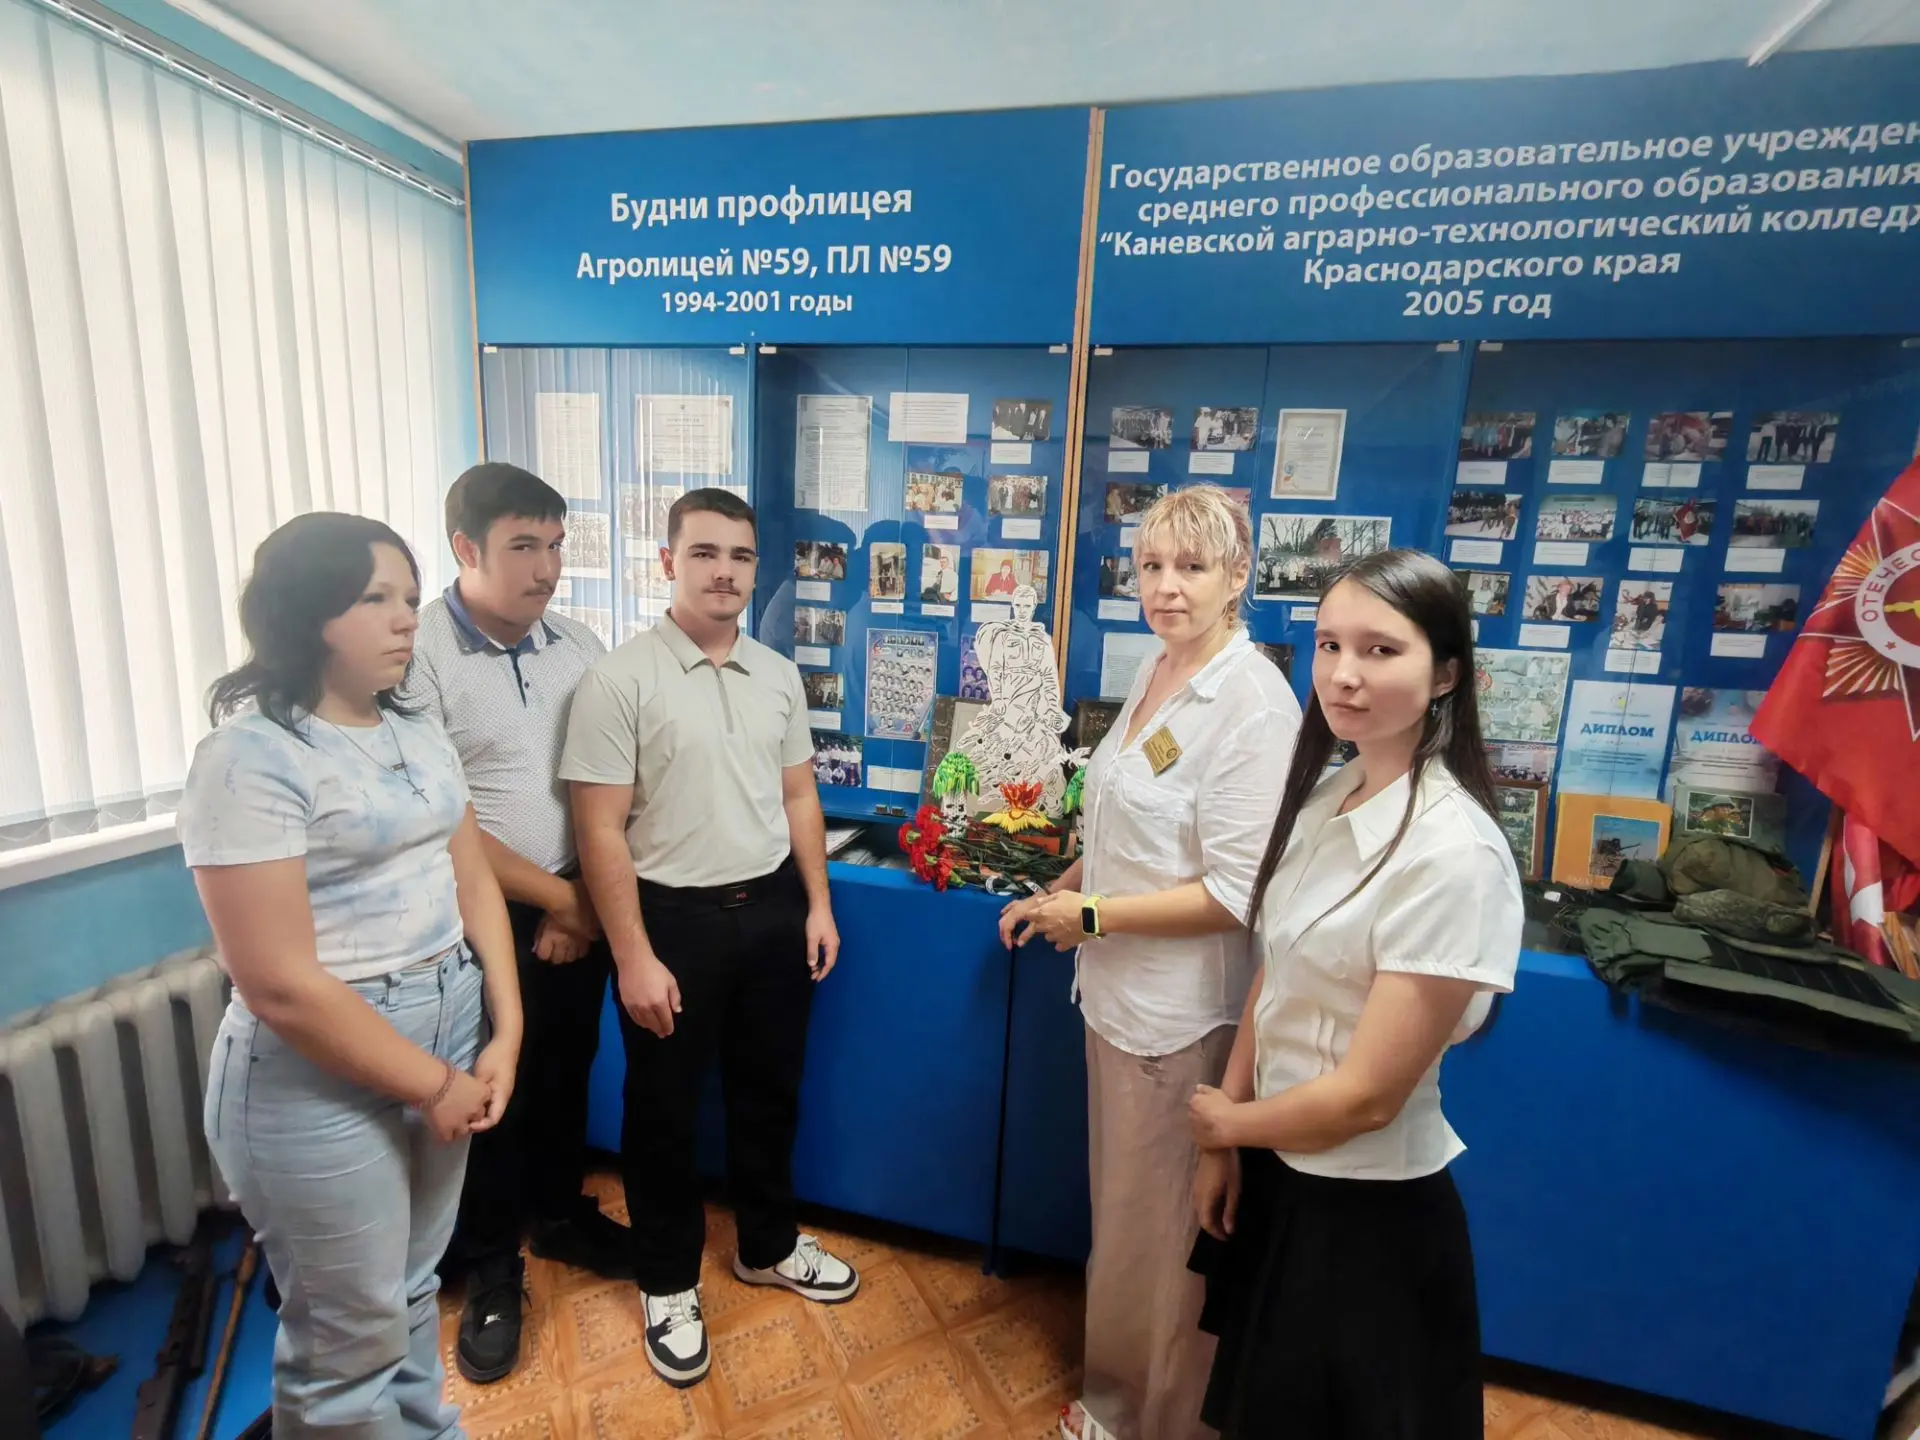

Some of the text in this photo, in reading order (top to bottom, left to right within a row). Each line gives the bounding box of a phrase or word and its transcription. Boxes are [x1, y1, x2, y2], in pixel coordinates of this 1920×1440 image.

[1110, 155, 1380, 193] Государственное
[1390, 136, 1712, 177] образовательное
[611, 184, 912, 230] Будни профлицея
[1139, 163, 1920, 227] среднего профессионального образования
[1284, 205, 1752, 256] аграрно-технологический
[577, 244, 952, 285] Агролицей №59, ПЛ №59
[1304, 253, 1681, 290] Краснодарского края
[662, 291, 852, 316] 1994-2001 годы
[1403, 290, 1551, 319] 2005 год
[1580, 722, 1655, 738] ДИПЛОМ
